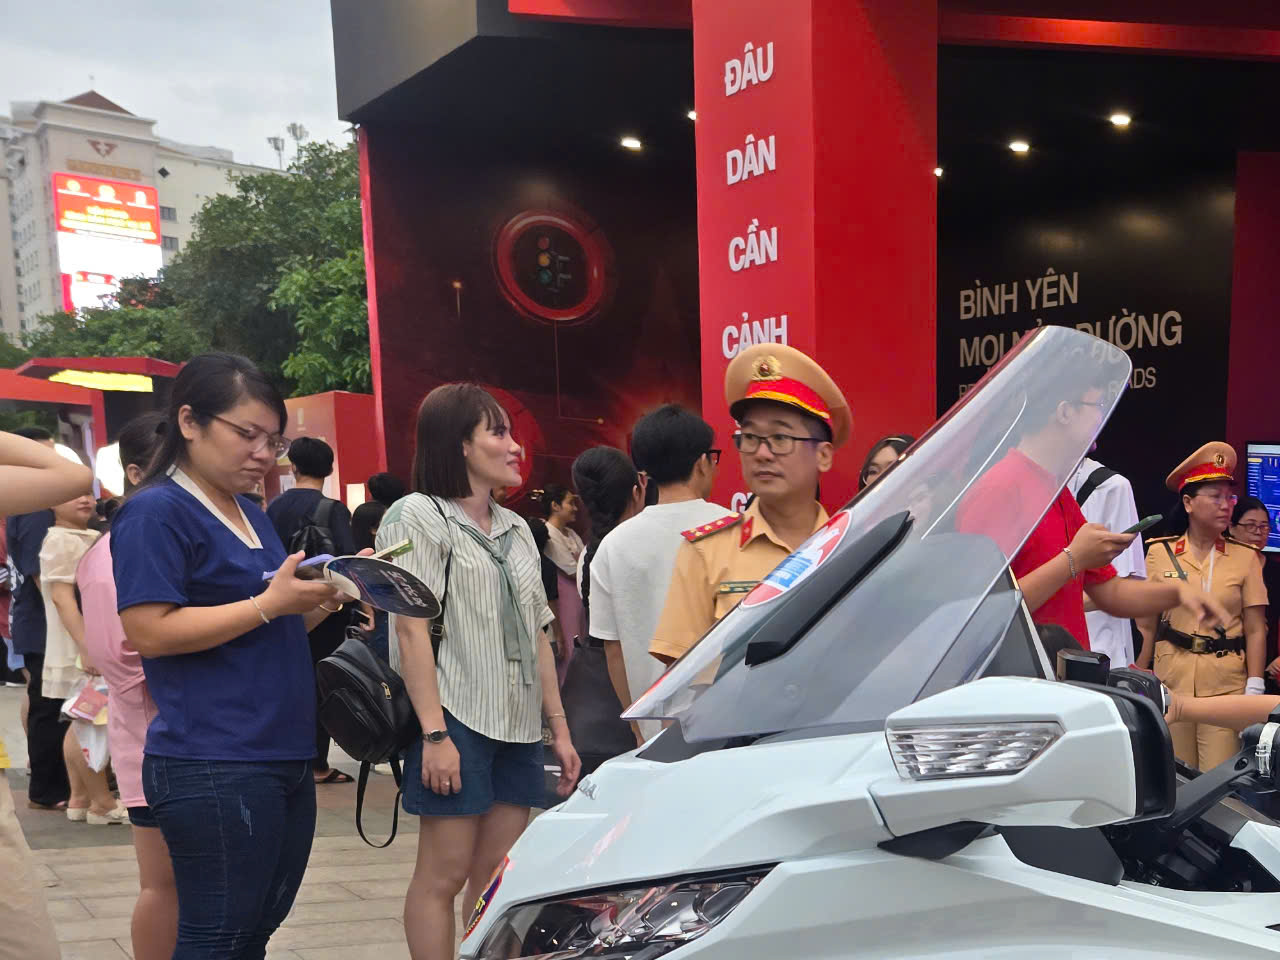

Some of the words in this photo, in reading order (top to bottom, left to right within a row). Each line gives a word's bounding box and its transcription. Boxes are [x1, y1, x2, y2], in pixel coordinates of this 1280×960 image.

[724, 42, 774, 97] ĐÂU
[726, 134, 776, 185] DÂN
[728, 218, 778, 272] CẦN
[959, 279, 1018, 320] BÌNH
[1025, 267, 1079, 311] YÊN
[722, 312, 788, 360] CẢNH
